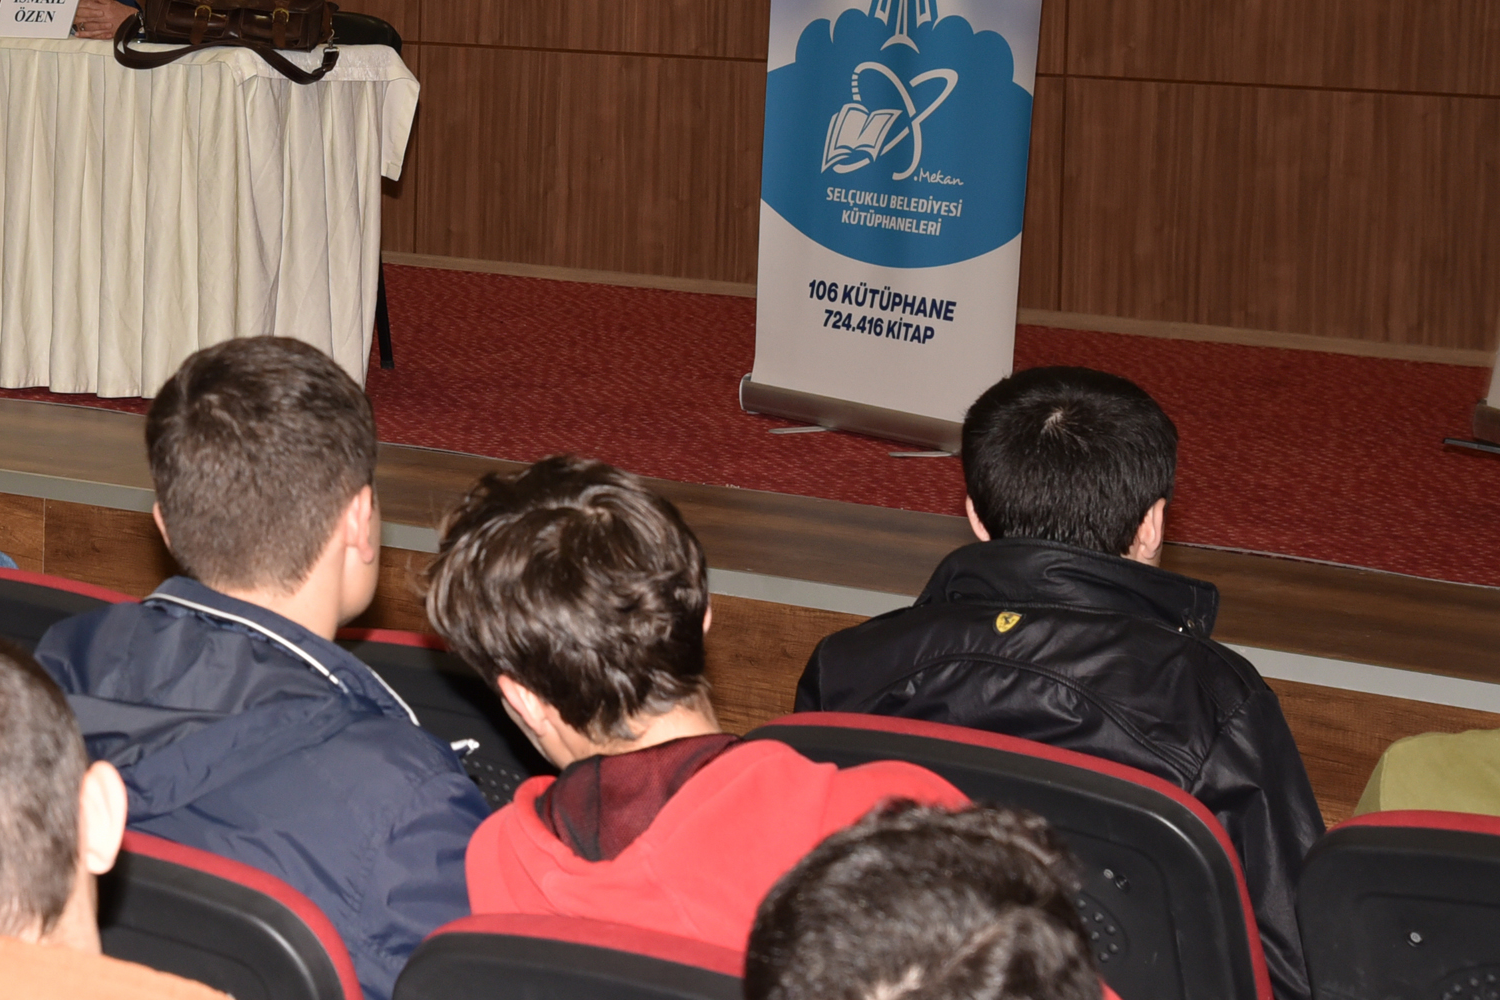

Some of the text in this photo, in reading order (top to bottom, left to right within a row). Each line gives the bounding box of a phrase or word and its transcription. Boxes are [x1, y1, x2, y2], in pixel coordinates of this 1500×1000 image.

[14, 7, 56, 22] ÖZEN
[826, 187, 963, 217] SELÇUKLU BELEDİYESİ
[841, 209, 942, 236] KÜTÜPHANELERİ
[808, 279, 957, 322] 106 KÜTÜPHANE
[823, 309, 935, 344] 724.416 KİTAP
